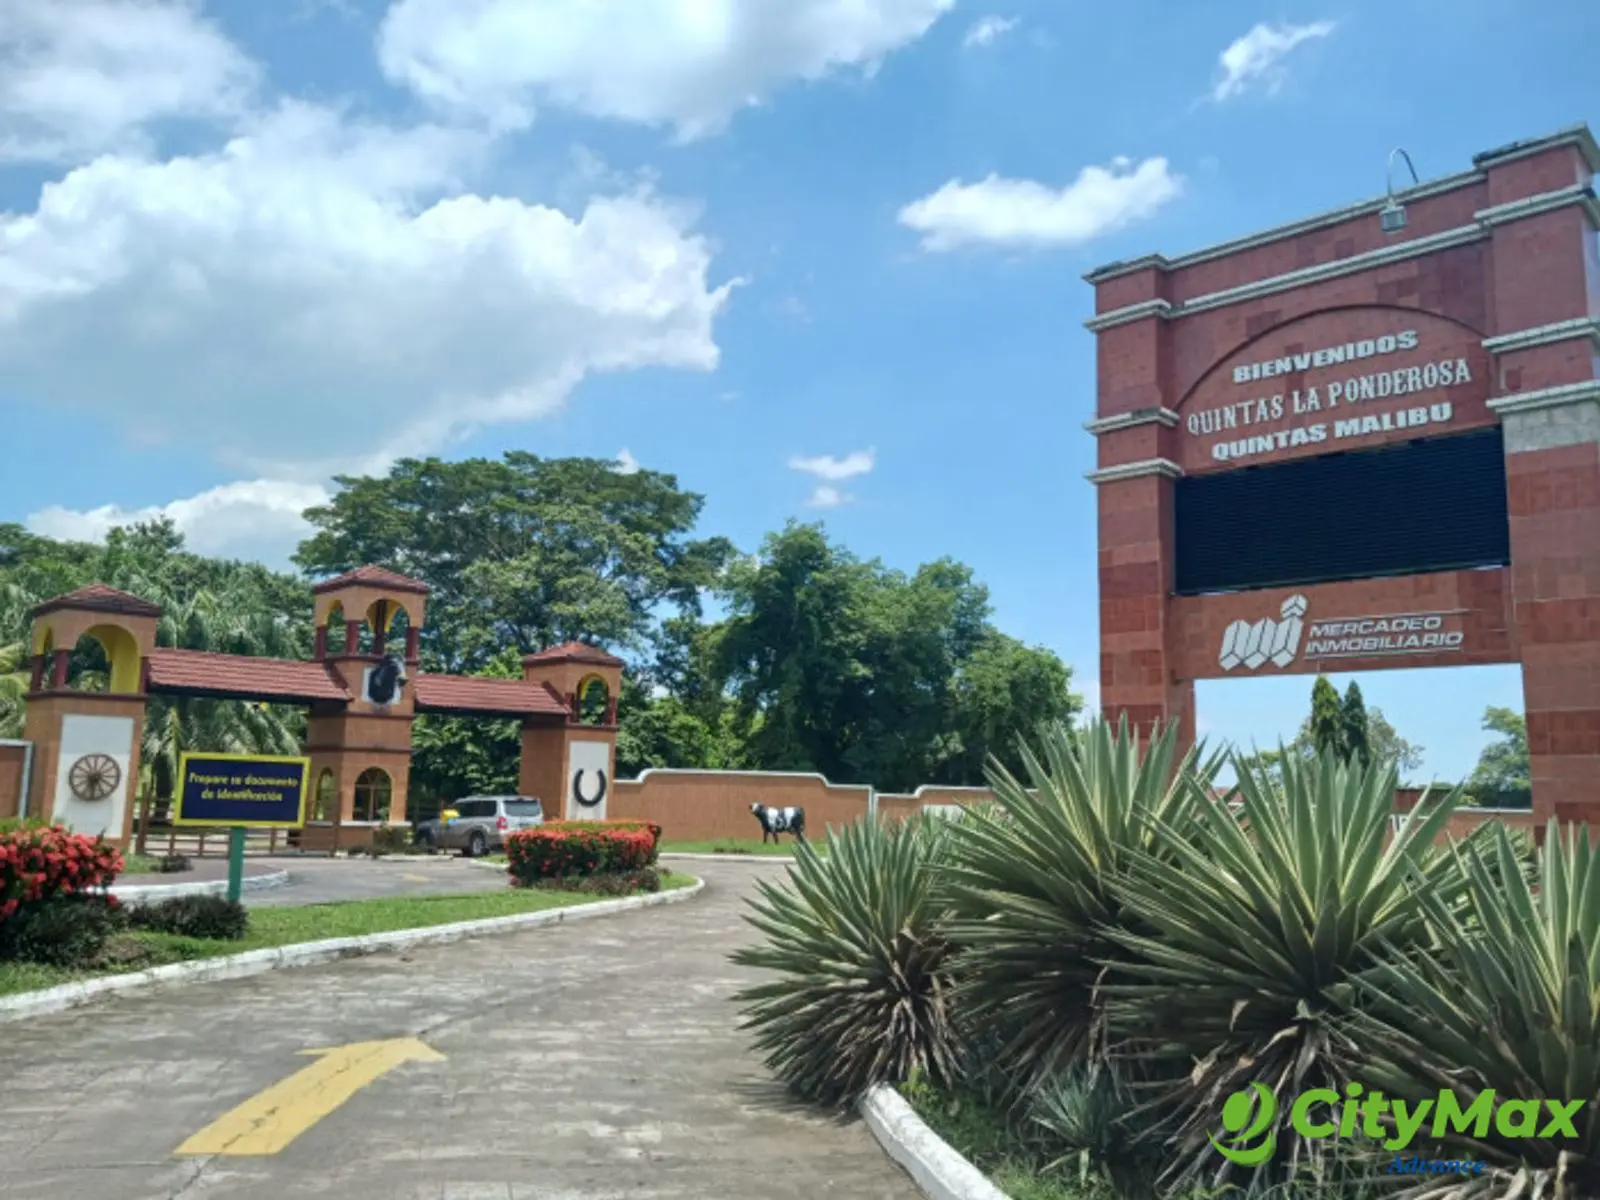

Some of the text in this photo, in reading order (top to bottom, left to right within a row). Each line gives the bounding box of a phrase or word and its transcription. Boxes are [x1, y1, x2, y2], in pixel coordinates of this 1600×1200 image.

[1232, 330, 1419, 384] BIENVENIDOS
[1187, 358, 1472, 436] QUINTAS LA PONDEROSA
[1211, 402, 1453, 461] QUINTAS MALIBU
[1305, 632, 1464, 654] INMOBILIARIO
[1309, 616, 1441, 638] MERCADEO
